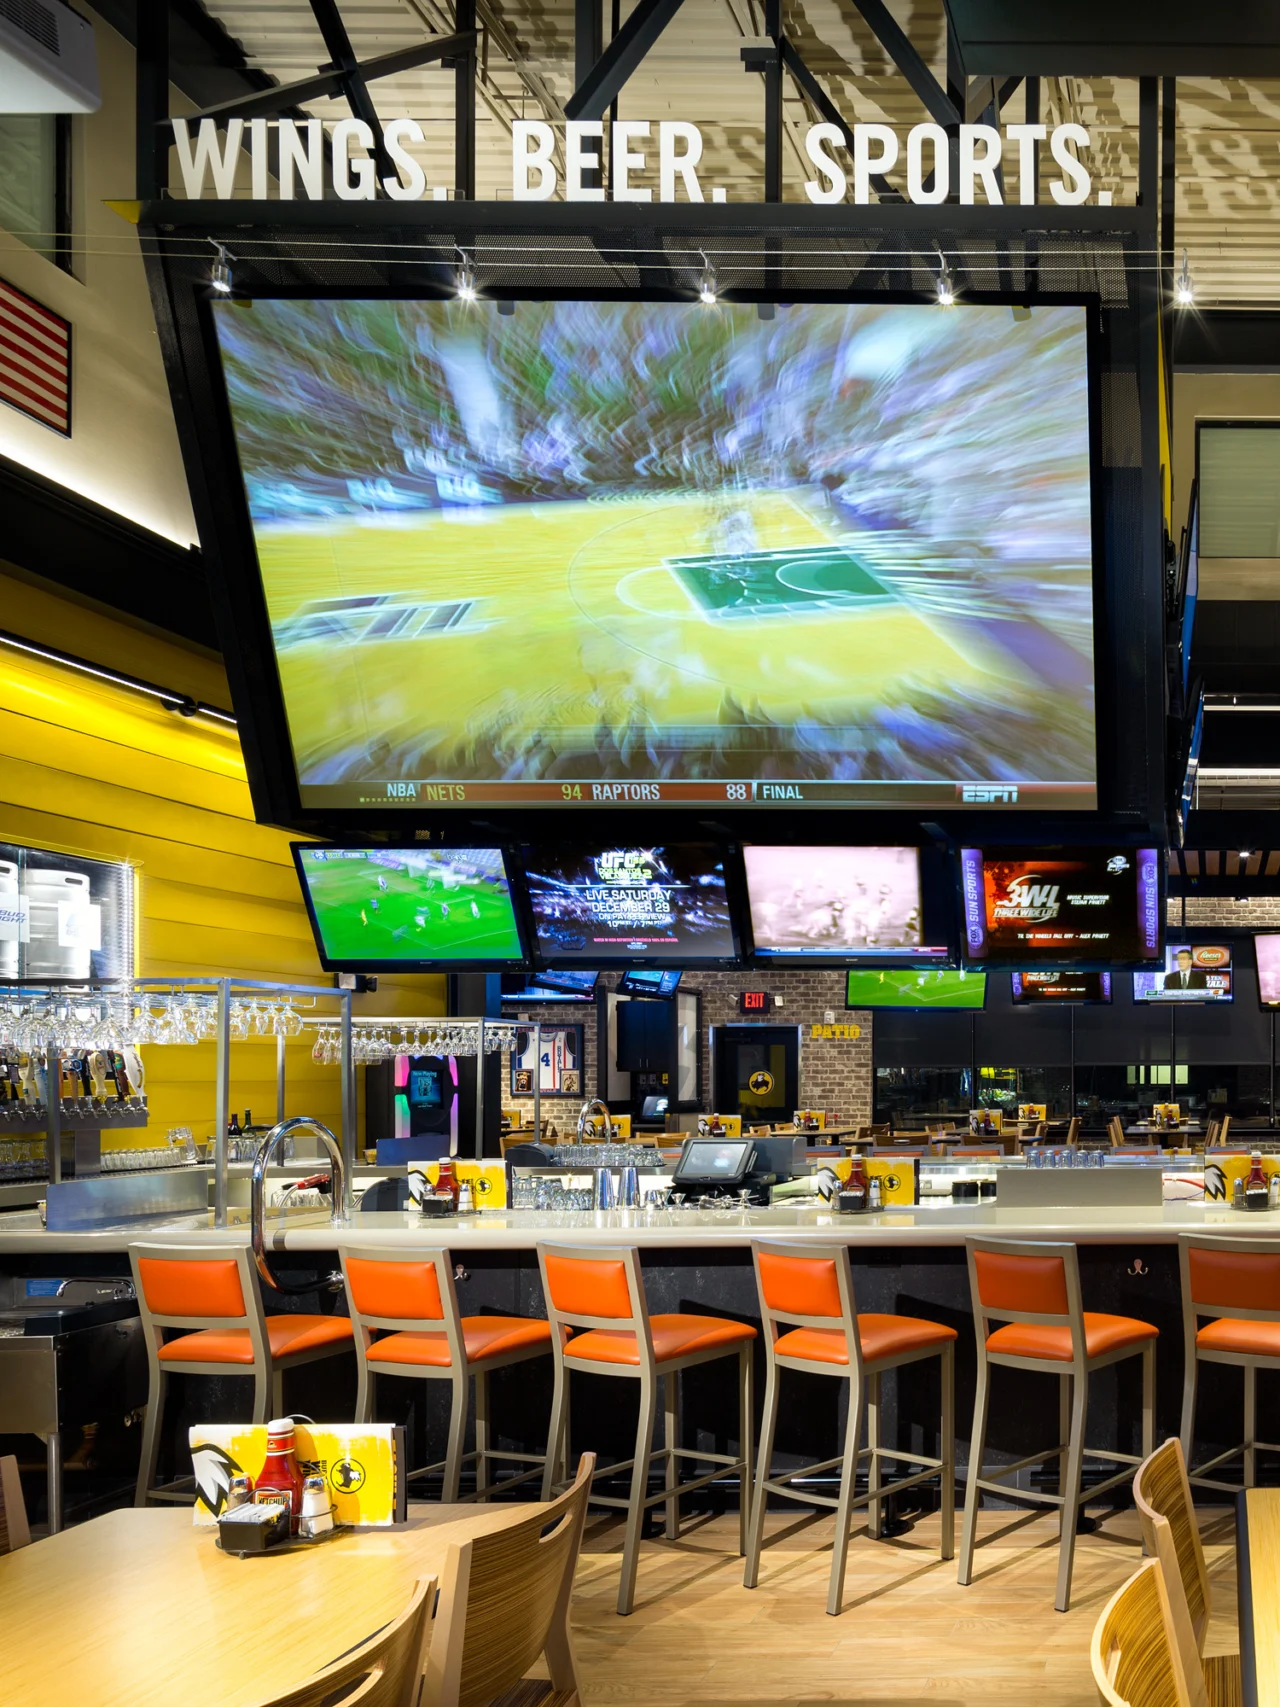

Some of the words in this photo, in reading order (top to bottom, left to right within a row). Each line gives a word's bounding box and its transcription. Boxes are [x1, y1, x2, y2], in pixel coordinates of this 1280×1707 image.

[171, 117, 448, 202] WINGS.
[512, 119, 728, 204] BEER.
[804, 122, 1112, 207] SPORTS.
[386, 783, 416, 798] NBA
[425, 784, 466, 801] NETS
[561, 783, 583, 800] 94
[592, 783, 661, 801] RAPTORS
[726, 783, 747, 800] 88
[762, 785, 804, 800] FINAL
[962, 785, 1018, 803] ESPN
[601, 852, 636, 868] UFC
[966, 860, 978, 903] SPORTS
[585, 889, 609, 901] LIVE
[611, 889, 672, 901] SATURDAY
[1145, 887, 1155, 907] SUN
[0, 909, 26, 918] BUD
[591, 902, 653, 913] DECEMBER
[655, 902, 670, 913] 29
[969, 904, 979, 922] SUN
[0, 915, 27, 923] IGHT
[1146, 909, 1156, 948] SPORTS
[745, 993, 764, 1008] EXIT
[811, 1024, 860, 1039] PATIO
